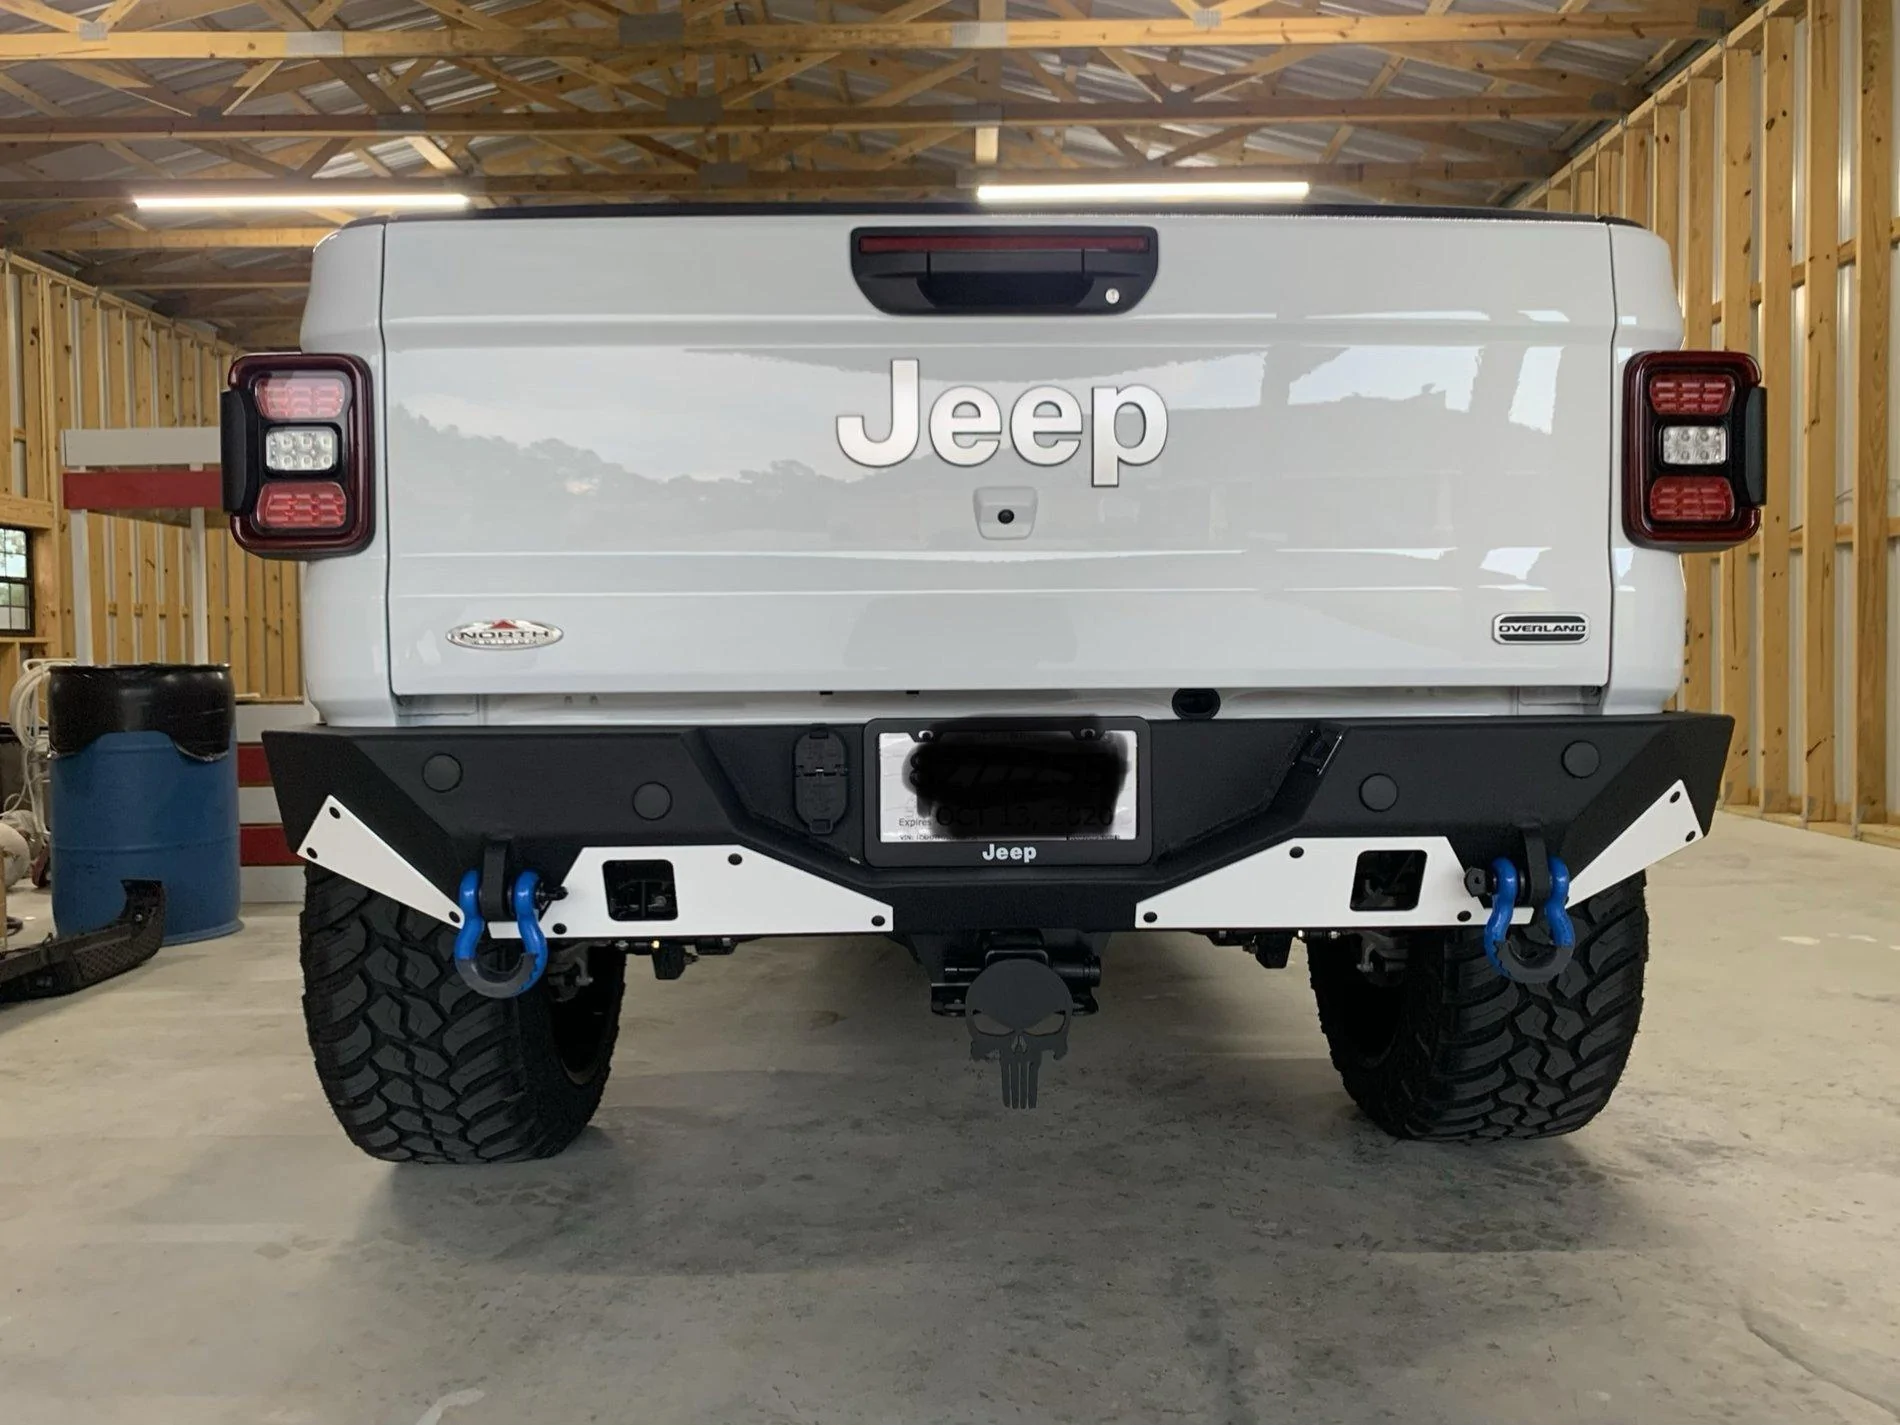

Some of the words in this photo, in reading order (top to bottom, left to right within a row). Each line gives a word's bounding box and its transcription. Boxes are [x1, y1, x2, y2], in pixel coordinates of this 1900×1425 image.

[836, 358, 1169, 488] Jeep
[1498, 624, 1587, 633] OVERLAND
[459, 631, 549, 639] NORTH
[898, 818, 932, 827] Expires
[982, 843, 1037, 863] Jeep
